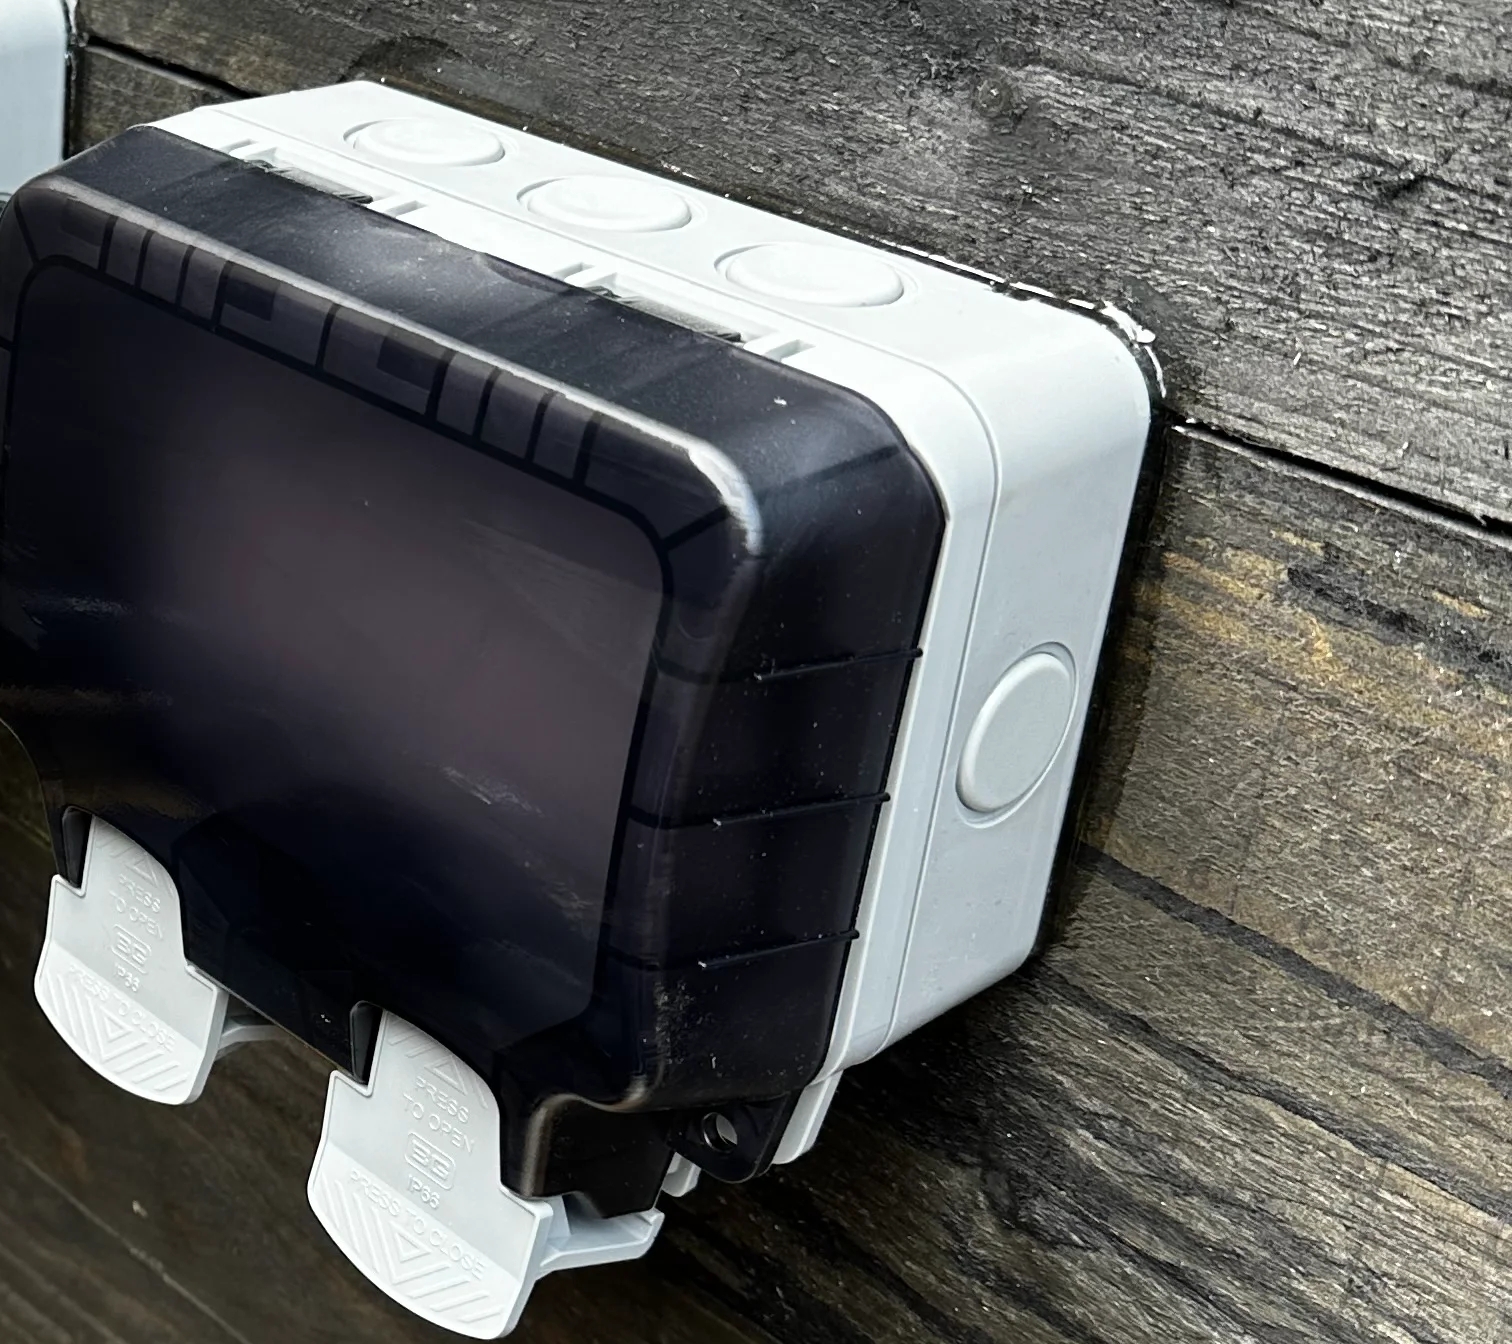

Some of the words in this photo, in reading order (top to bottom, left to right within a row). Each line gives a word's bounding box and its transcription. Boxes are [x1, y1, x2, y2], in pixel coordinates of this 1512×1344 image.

[108, 889, 127, 914] TO
[129, 905, 165, 940] OPEN
[117, 873, 162, 913] PRESS
[68, 964, 110, 1002] PRESS
[112, 992, 130, 1017] TO
[131, 1010, 177, 1053] CLOSE
[402, 1090, 425, 1120] TO
[427, 1113, 475, 1154] OPEN
[415, 1075, 470, 1124] PRESS
[348, 1166, 401, 1217] PRESS
[405, 1205, 428, 1236] TO
[429, 1228, 488, 1281] CLOSE
